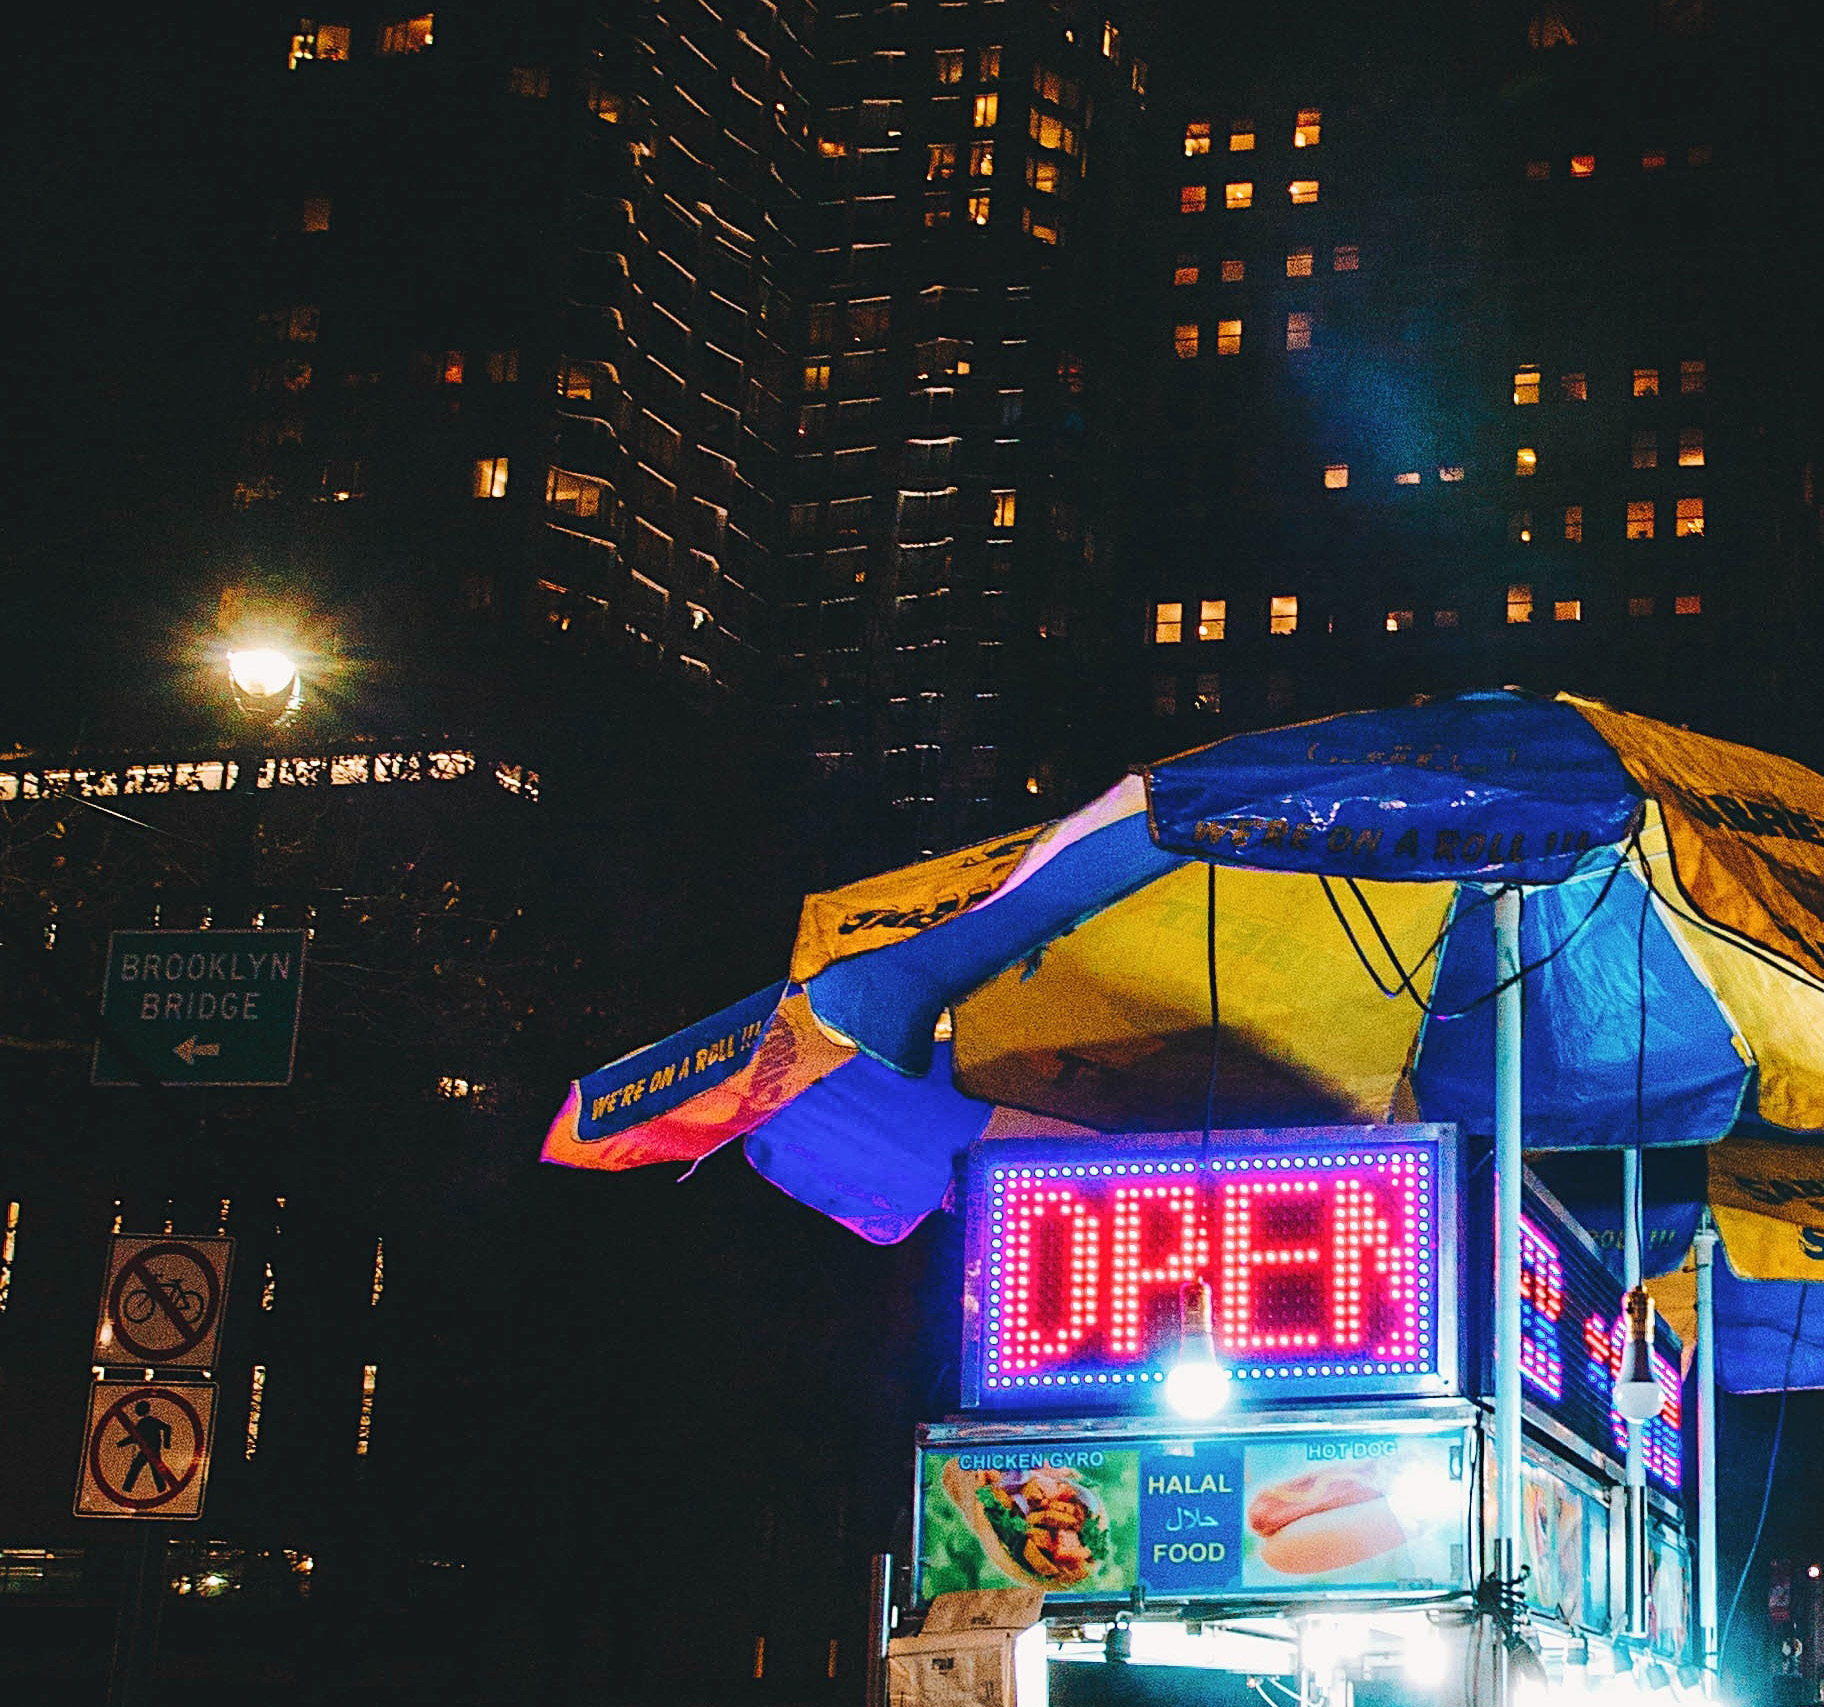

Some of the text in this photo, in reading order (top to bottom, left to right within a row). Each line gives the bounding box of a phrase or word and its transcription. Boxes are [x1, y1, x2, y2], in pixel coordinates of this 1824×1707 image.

[1327, 826, 1384, 855] ON
[1394, 829, 1419, 857] A
[1435, 831, 1524, 863] ROLL
[121, 952, 291, 981] BROOKLYN
[140, 992, 261, 1020] BRIDGE
[591, 1078, 646, 1121] WE'RE
[649, 1063, 677, 1094] ON
[678, 1056, 690, 1082] A
[695, 1033, 735, 1074] ROLL
[1002, 1178, 1412, 1360] OPEN
[959, 1450, 1104, 1471] CHICKEN GYRO
[1306, 1440, 1397, 1461] HOT DOG
[1147, 1474, 1233, 1496] HALAL
[1165, 1506, 1220, 1532] حلال
[1153, 1542, 1226, 1564] FOOD
